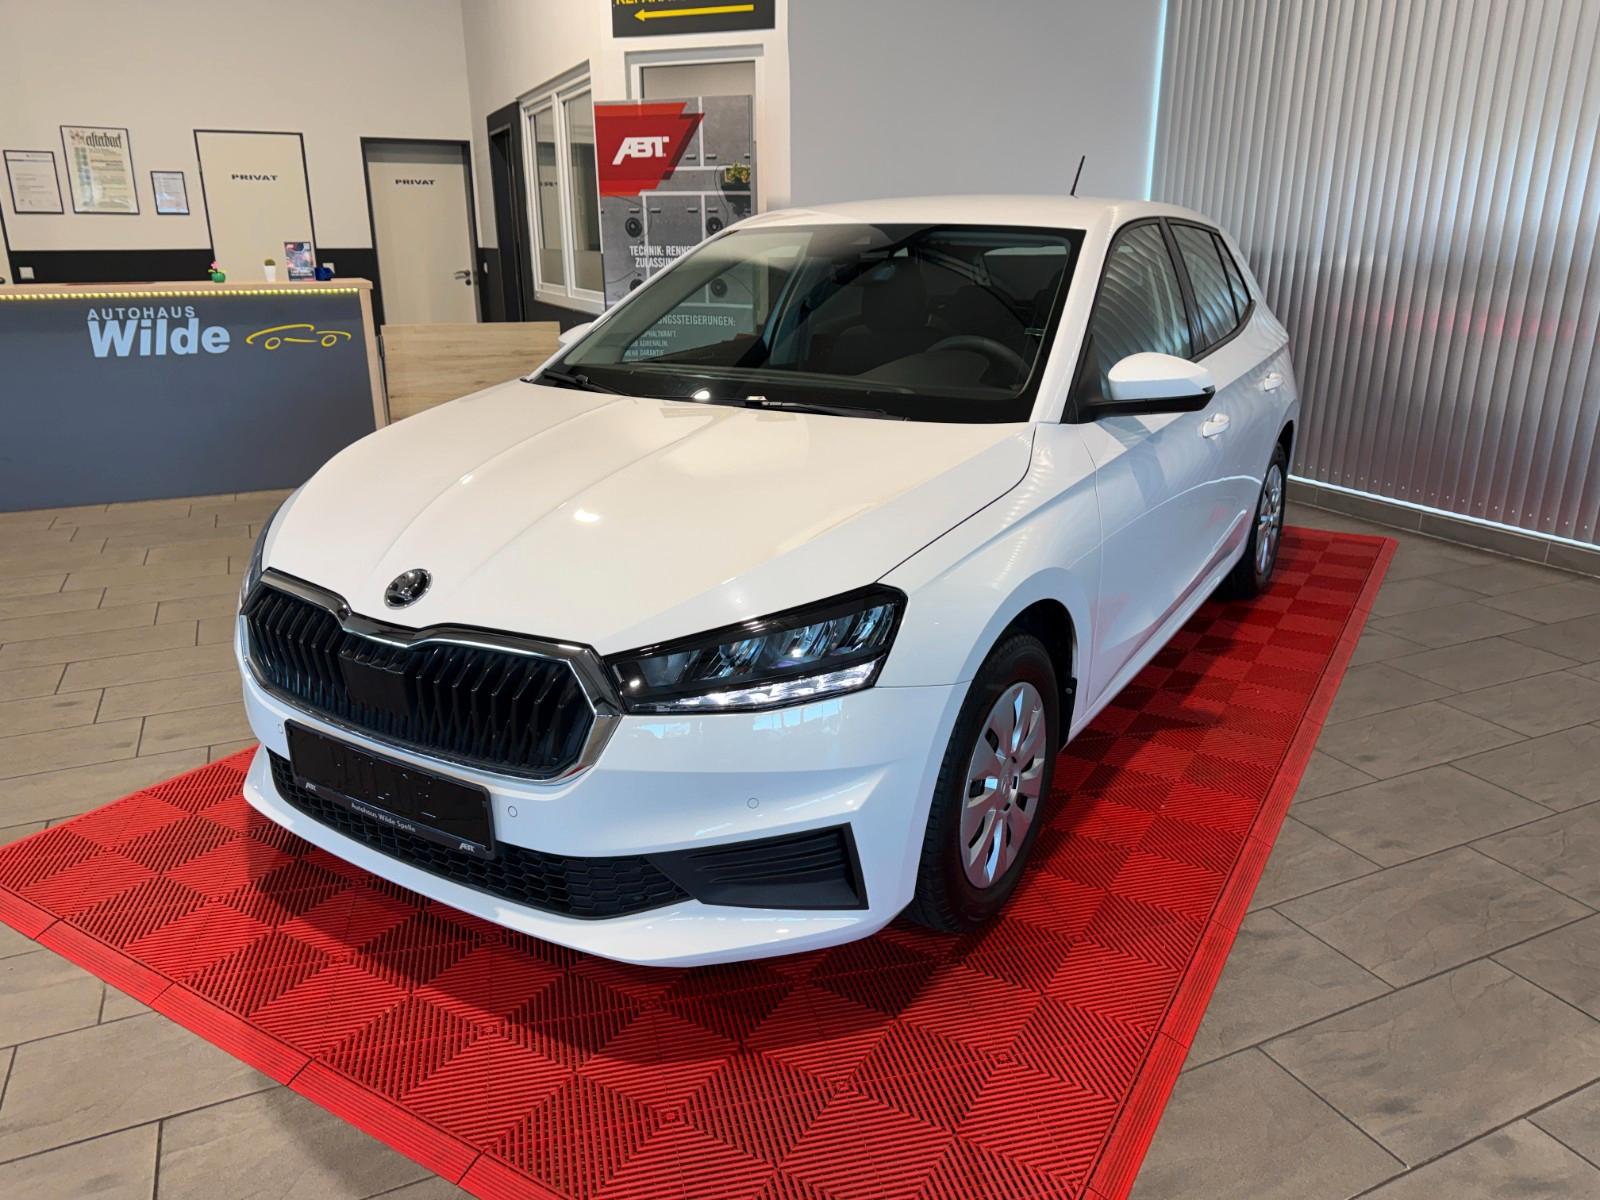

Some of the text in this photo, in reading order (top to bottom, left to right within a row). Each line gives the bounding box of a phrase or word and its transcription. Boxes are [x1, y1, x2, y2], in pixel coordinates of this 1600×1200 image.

[612, 136, 670, 165] ABT
[231, 174, 278, 182] PRIVAT
[629, 245, 664, 256] TECHNIK:
[635, 257, 677, 268] ZULASSUN
[87, 305, 196, 321] AUTOHAUS
[88, 317, 230, 358] Wilde
[351, 802, 416, 833] Autohaus Wilde Spelle
